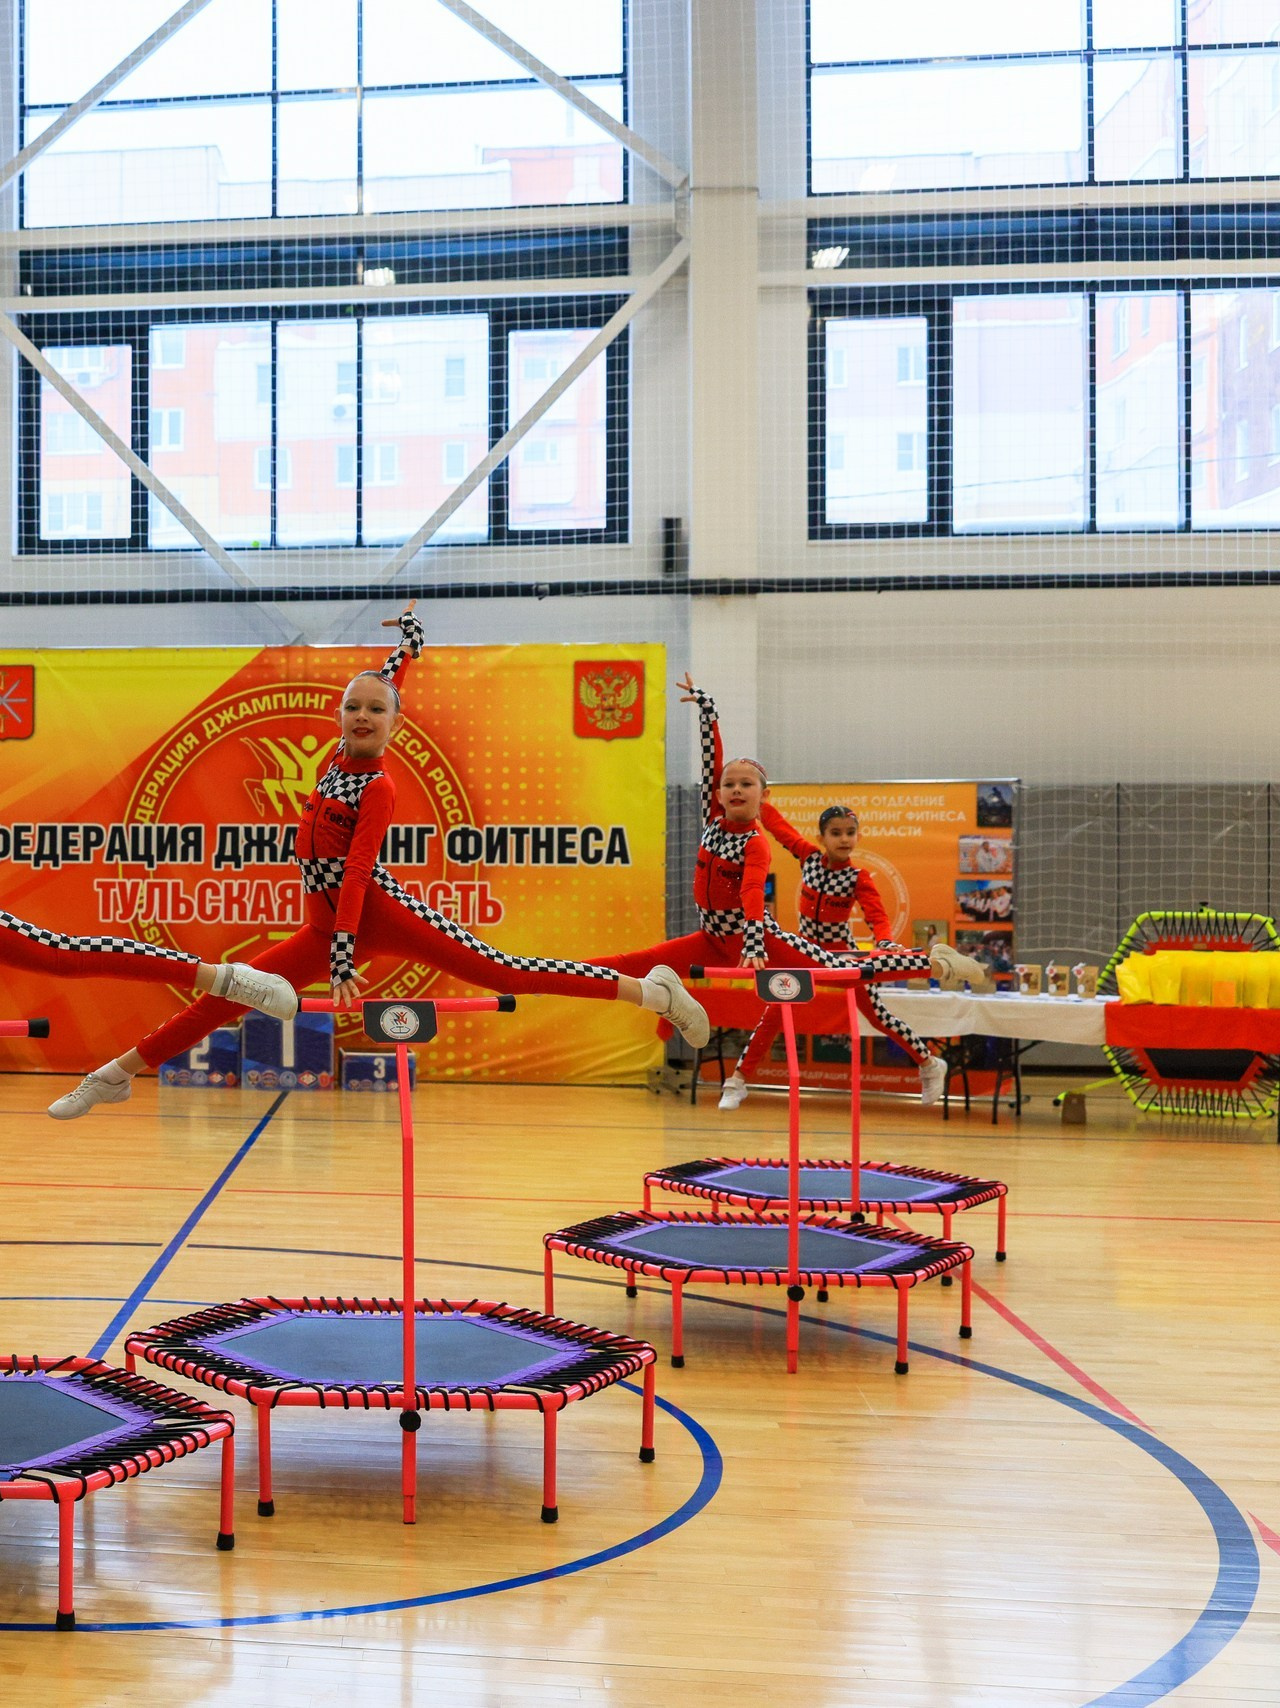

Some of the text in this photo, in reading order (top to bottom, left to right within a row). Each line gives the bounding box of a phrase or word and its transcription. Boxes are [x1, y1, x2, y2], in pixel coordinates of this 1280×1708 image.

[134, 692, 464, 829] ДЕРАЦИЯ ДЖАМПИНГ РОСС
[871, 795, 946, 807] ОТДЕЛЕНИЕ
[906, 811, 967, 822] ФИТНЕСА
[213, 824, 435, 869] ДЖАНГ
[447, 825, 630, 866] ФИТНЕСА
[95, 880, 304, 923] ТУЛЬСКАЯ
[190, 1034, 210, 1070] 2
[373, 1057, 386, 1079] 3
